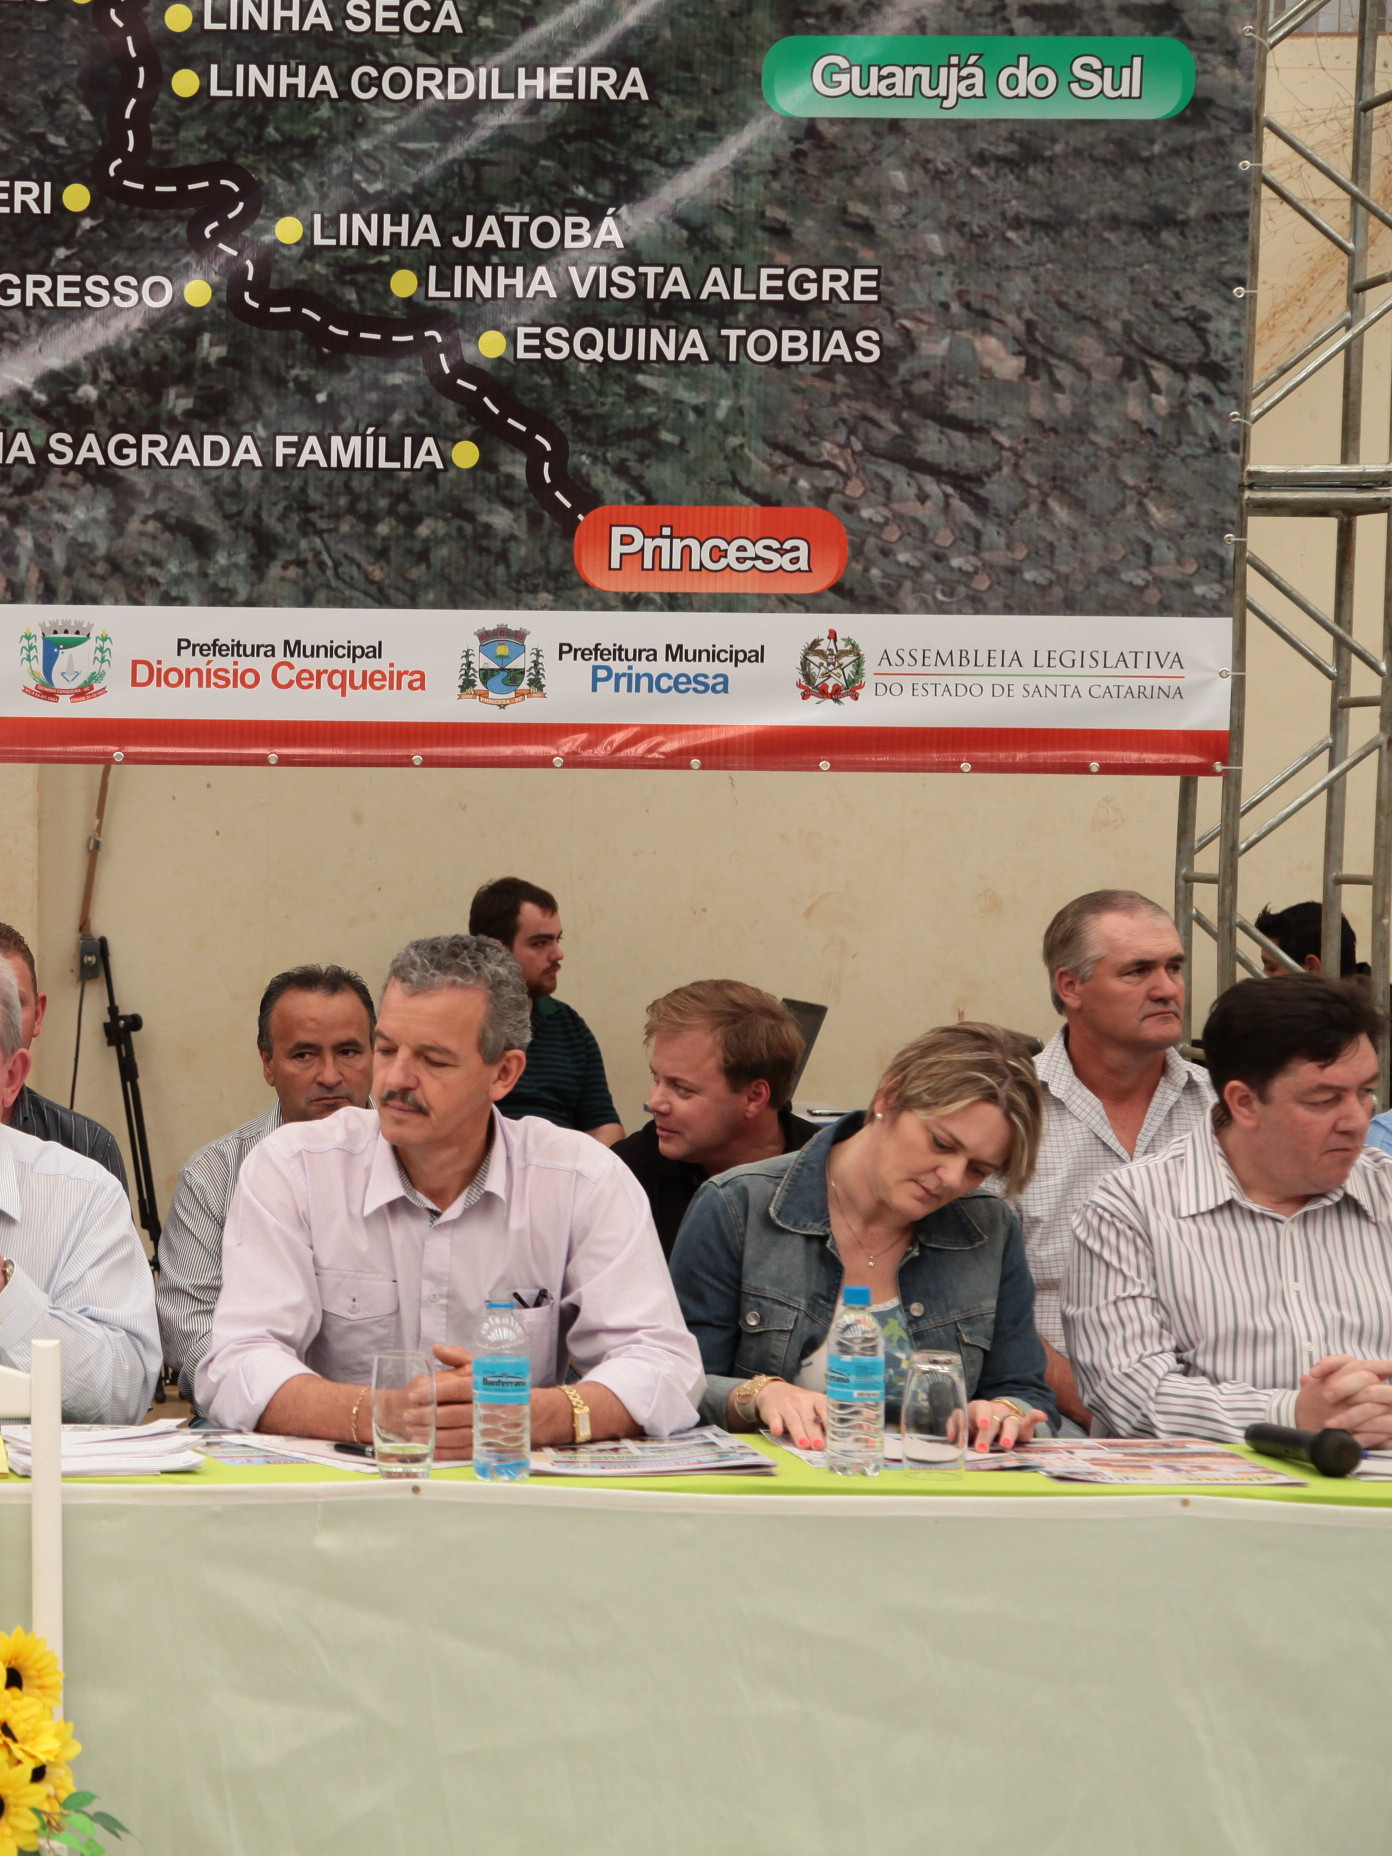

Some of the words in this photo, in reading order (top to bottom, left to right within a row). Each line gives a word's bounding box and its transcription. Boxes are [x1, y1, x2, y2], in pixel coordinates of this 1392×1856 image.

[203, 0, 333, 31] LINHA
[345, 0, 463, 33] SECA
[210, 64, 338, 98] LINHA
[350, 65, 649, 101] CORDILHEIRA
[812, 53, 985, 109] Guarujá
[997, 54, 1057, 98] do
[1069, 54, 1143, 98] Sul
[313, 214, 439, 246] LINHA
[453, 207, 624, 249] JATOBÁ
[428, 266, 556, 298] LINHA
[569, 266, 690, 300] VISTA
[702, 267, 879, 301] ALEGRE
[516, 327, 708, 363] ESQUINA
[722, 328, 881, 363] TOBIAS
[47, 433, 262, 467] SAGRADA
[275, 428, 444, 469] FAMÍLIA
[609, 525, 811, 573] Princesa
[176, 637, 276, 660] Prefeitura
[282, 639, 383, 662] Municipal
[557, 642, 658, 664] Prefeitura
[665, 644, 765, 668] Municipal
[878, 648, 1025, 669] ASSEMBLEIA
[1033, 649, 1185, 671] LEGISLATIVA
[129, 659, 262, 692] Dionísio
[269, 661, 427, 699] Cerqueira
[590, 665, 730, 695] Princesa
[874, 682, 905, 698] DO
[910, 682, 985, 698] ESTADO
[991, 683, 1016, 698] DE
[1022, 682, 1083, 698] SANTA
[1088, 683, 1185, 700] CATARINA
